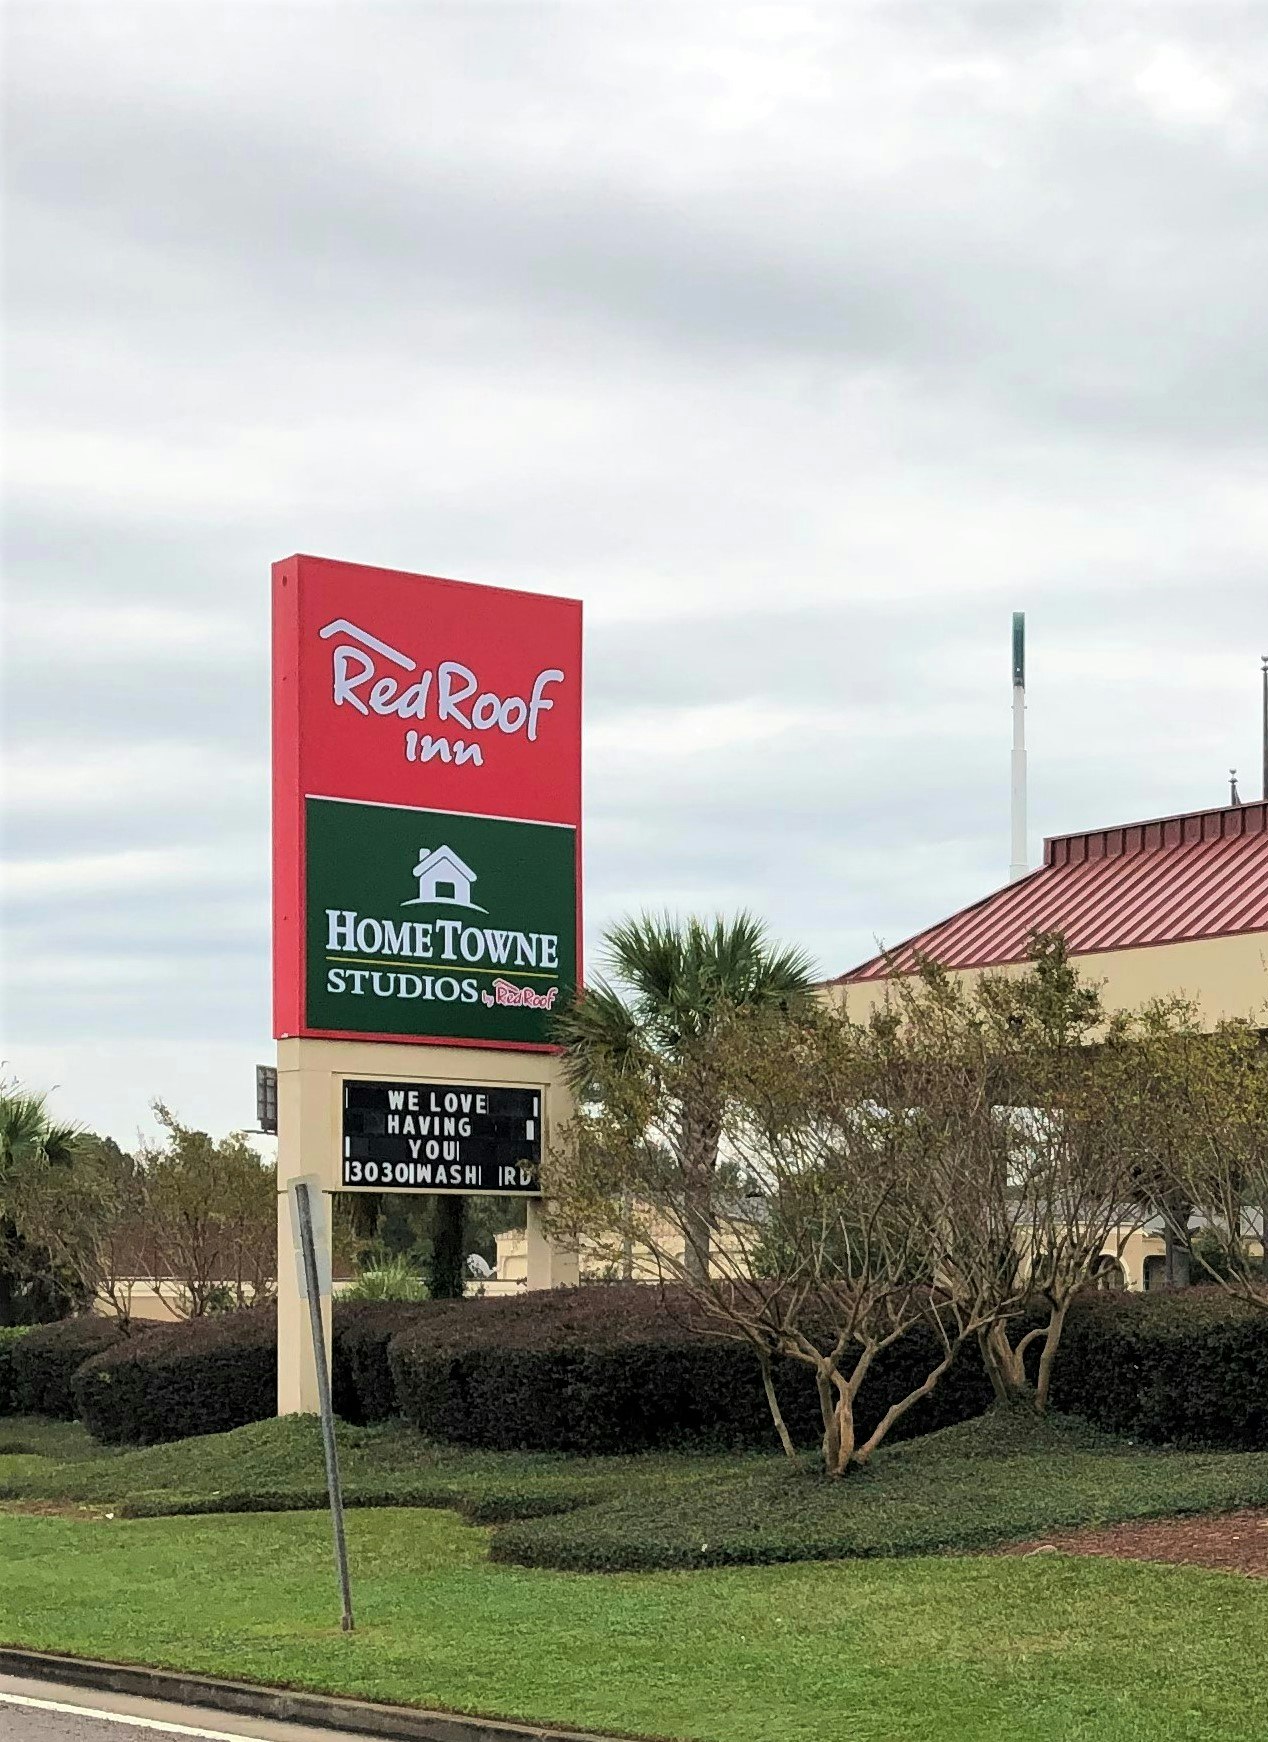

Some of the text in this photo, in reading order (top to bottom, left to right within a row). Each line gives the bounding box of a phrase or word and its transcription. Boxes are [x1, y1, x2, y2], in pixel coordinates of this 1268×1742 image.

[327, 969, 479, 1003] STUDIOS
[388, 1090, 488, 1114] WE LOVE
[387, 1114, 472, 1137] HAVING
[408, 1139, 456, 1161] YOU
[351, 1161, 409, 1183] 3030
[417, 1163, 477, 1185] WASH
